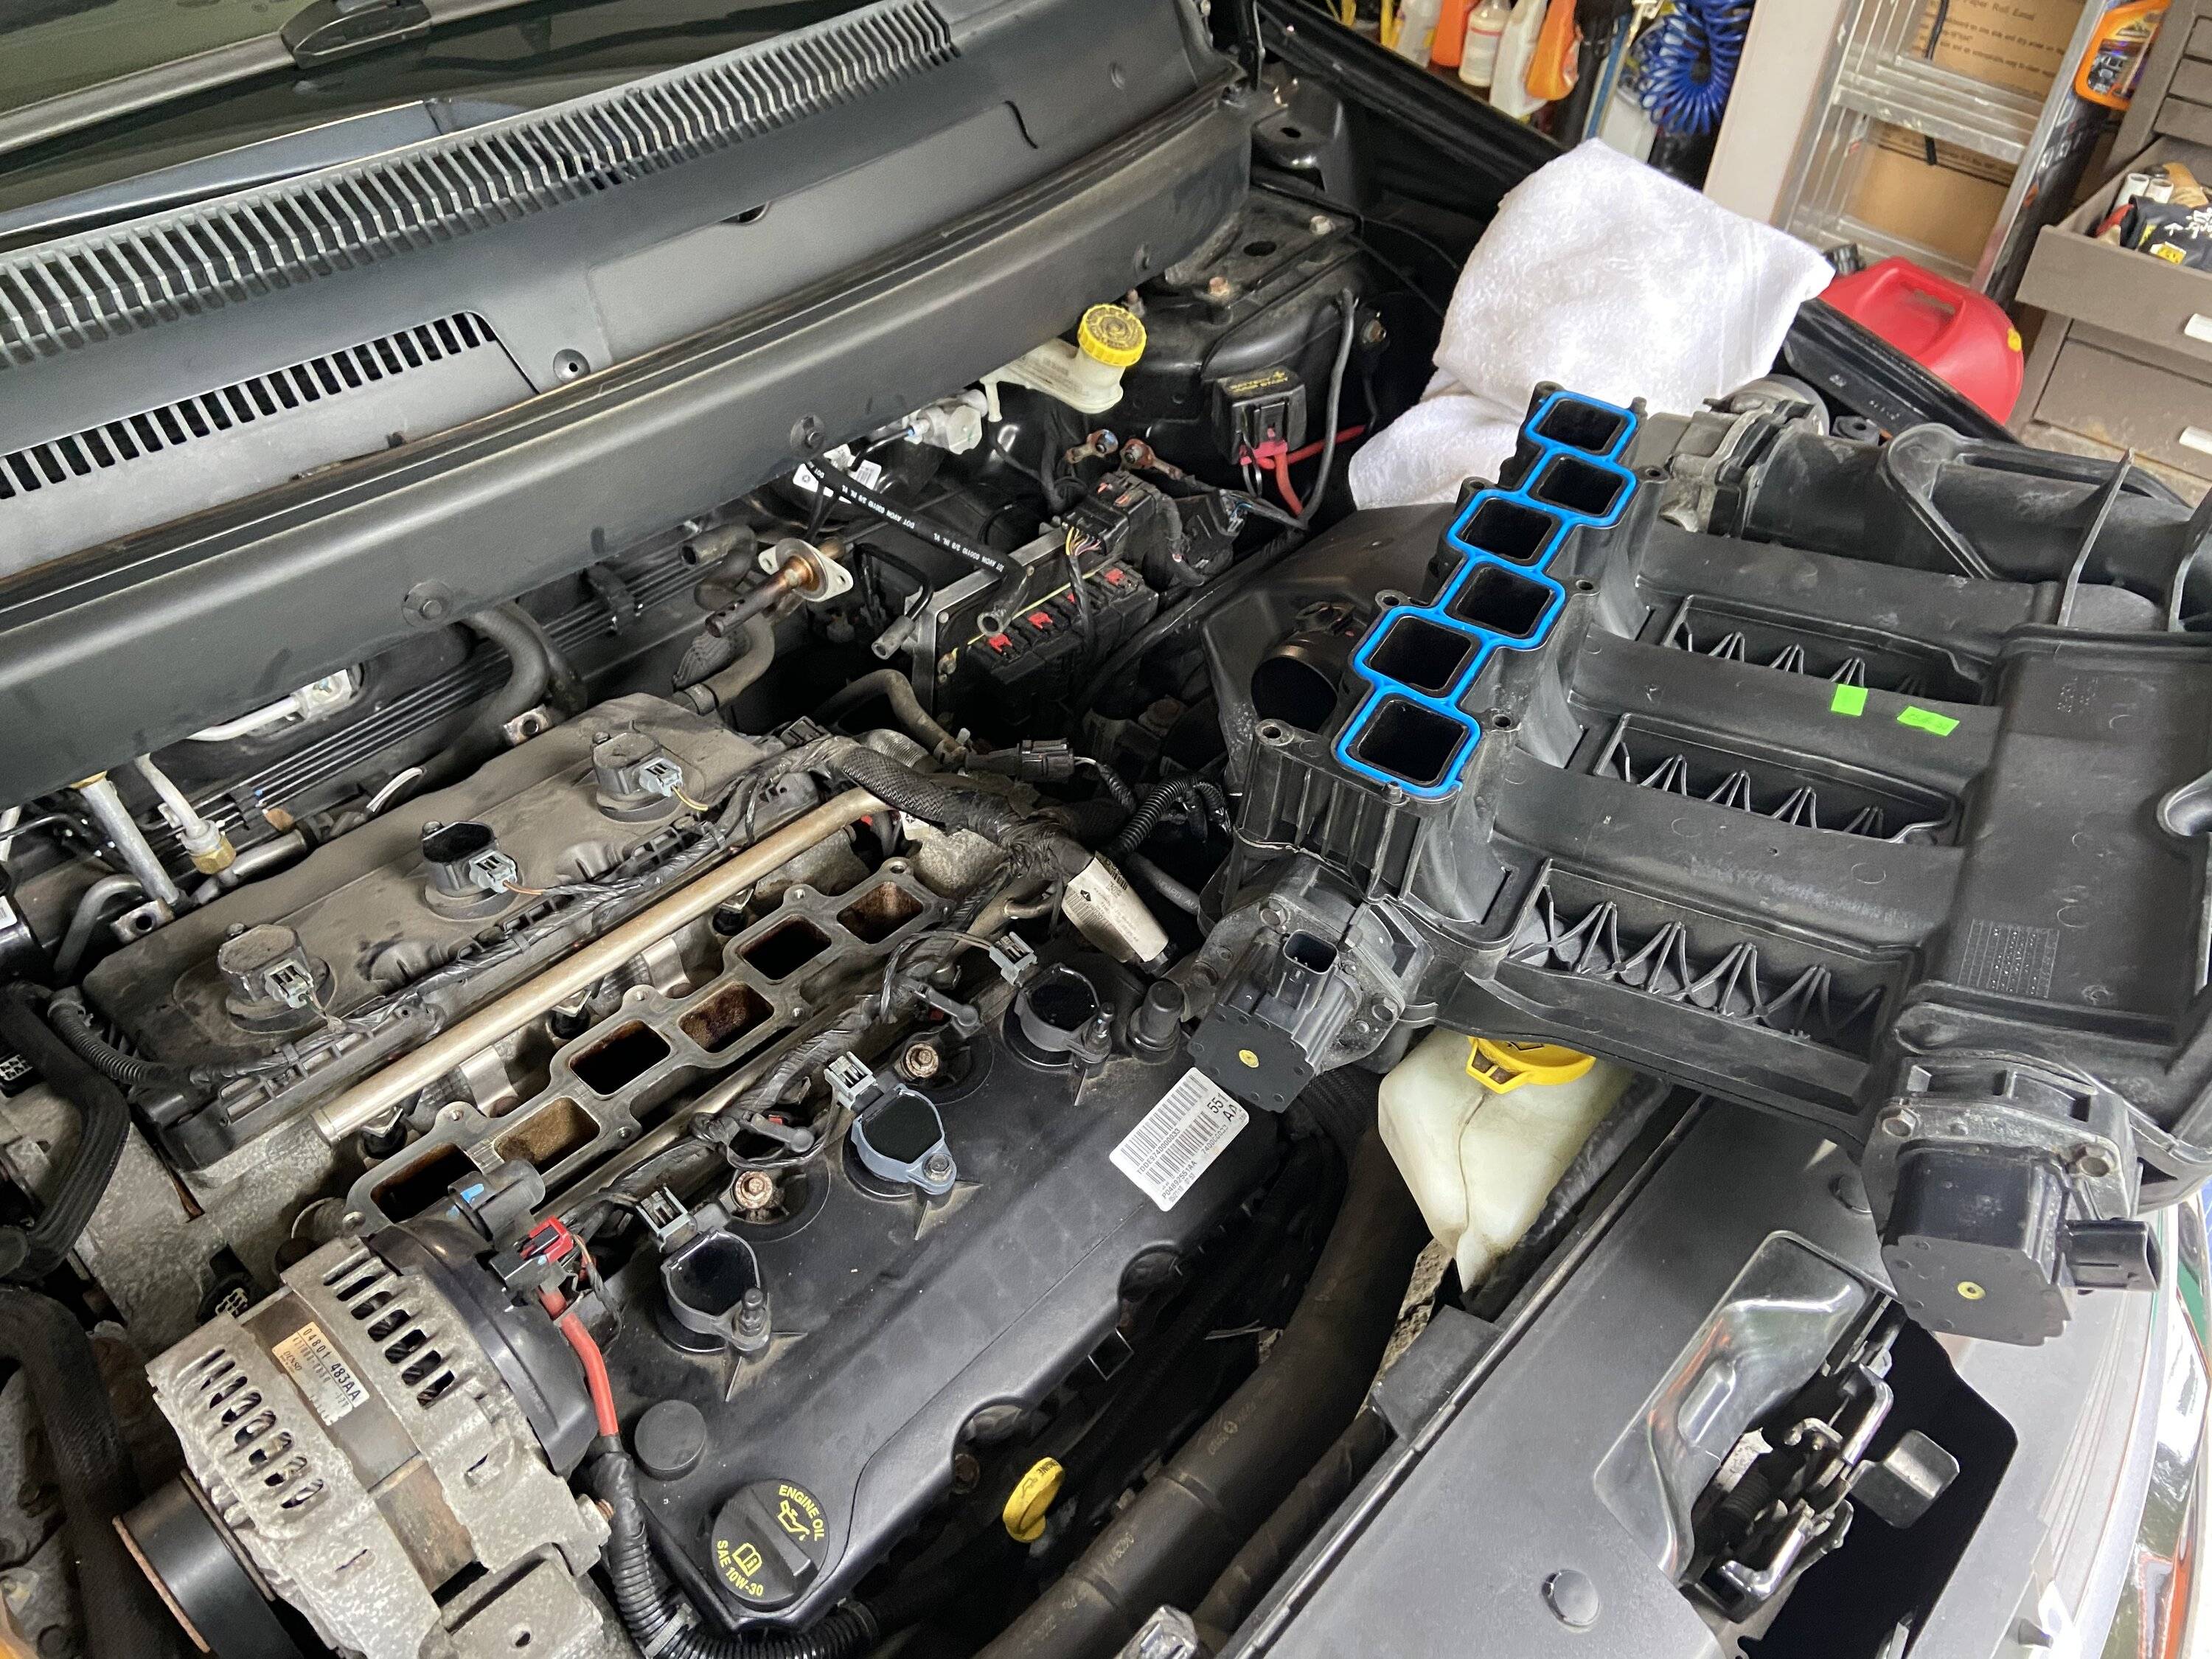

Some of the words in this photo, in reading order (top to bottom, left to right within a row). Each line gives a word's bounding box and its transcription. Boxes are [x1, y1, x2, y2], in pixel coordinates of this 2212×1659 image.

[902, 518, 916, 529] DOT
[1206, 1093, 1229, 1114] 551
[283, 1350, 302, 1371] DENSO
[303, 1328, 332, 1359] 04801
[330, 1363, 361, 1401] 483AA
[778, 1484, 820, 1519] ENGINE
[812, 1518, 825, 1542] OIL
[717, 1539, 731, 1568] SAE
[725, 1568, 765, 1597] 10W-30
